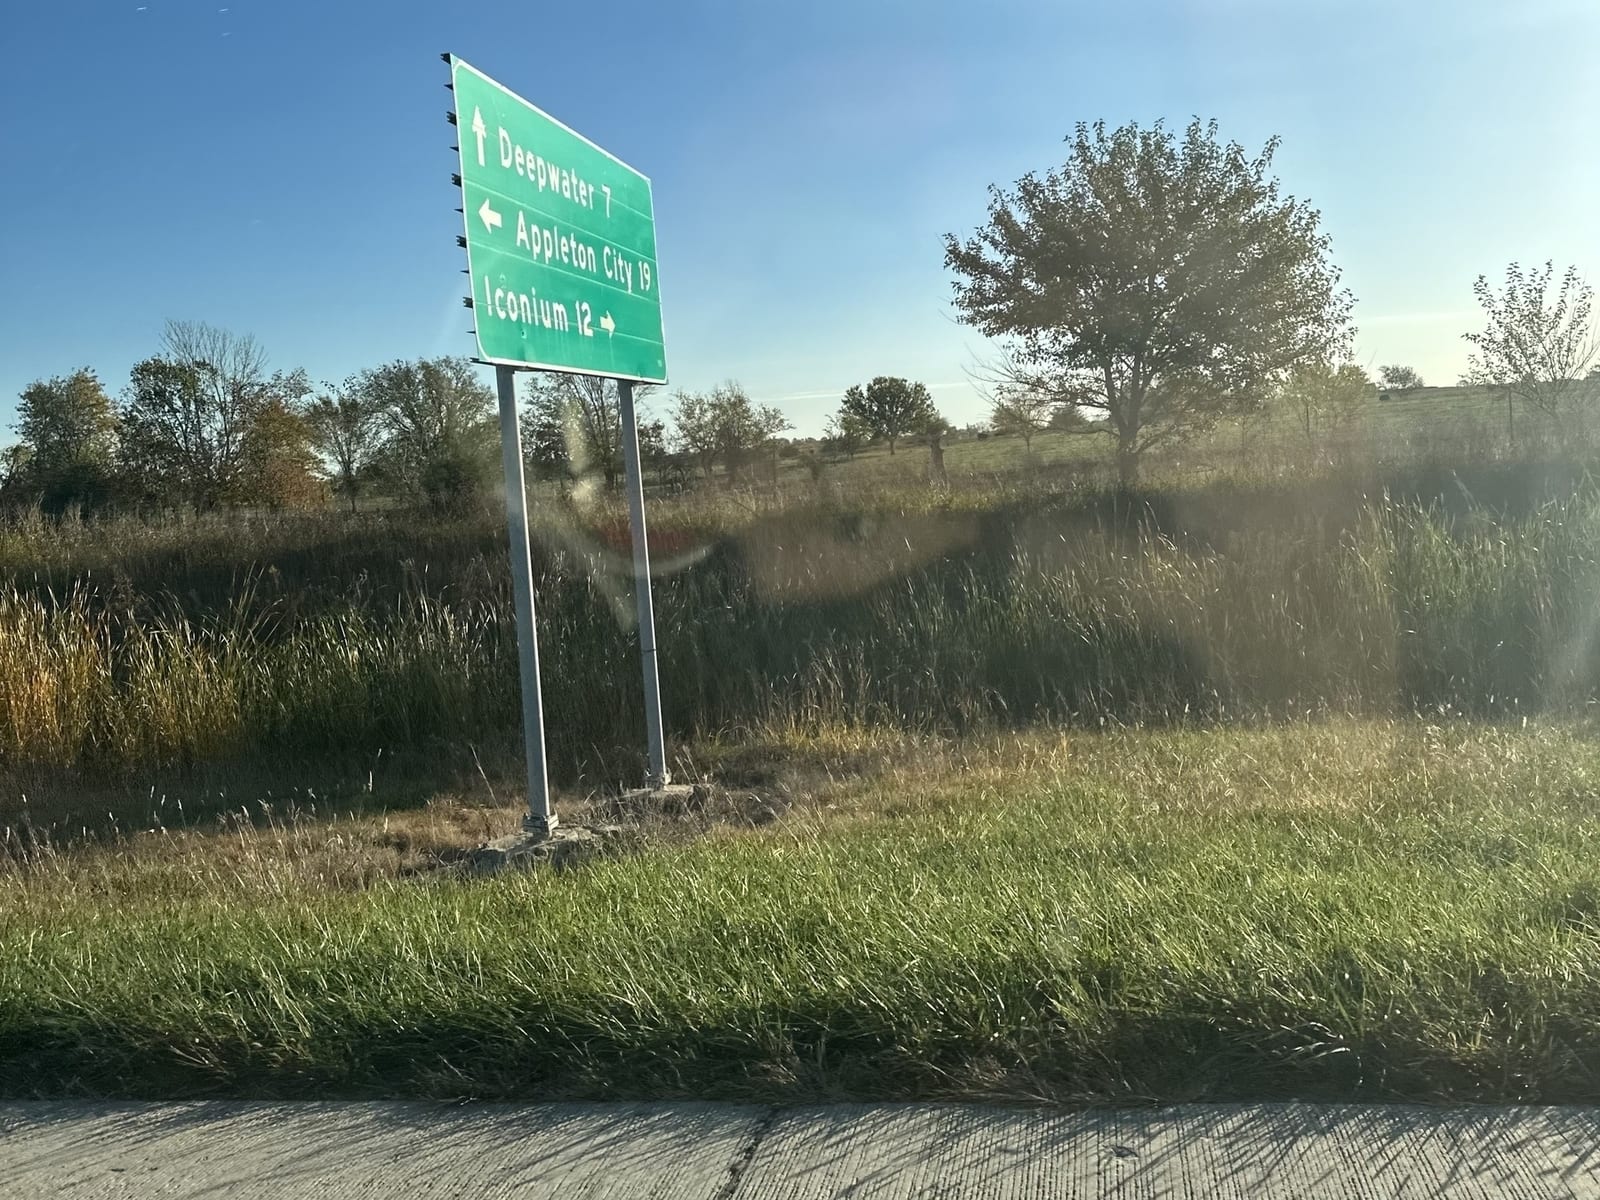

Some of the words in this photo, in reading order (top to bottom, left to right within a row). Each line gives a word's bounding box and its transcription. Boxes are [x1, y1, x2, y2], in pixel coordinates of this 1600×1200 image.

[498, 126, 594, 210] Deepwater
[602, 184, 611, 218] 7
[516, 210, 596, 273] Appleton
[603, 245, 633, 294] City
[638, 260, 651, 291] 19
[484, 275, 569, 332] Iconium
[575, 301, 594, 337] 12
